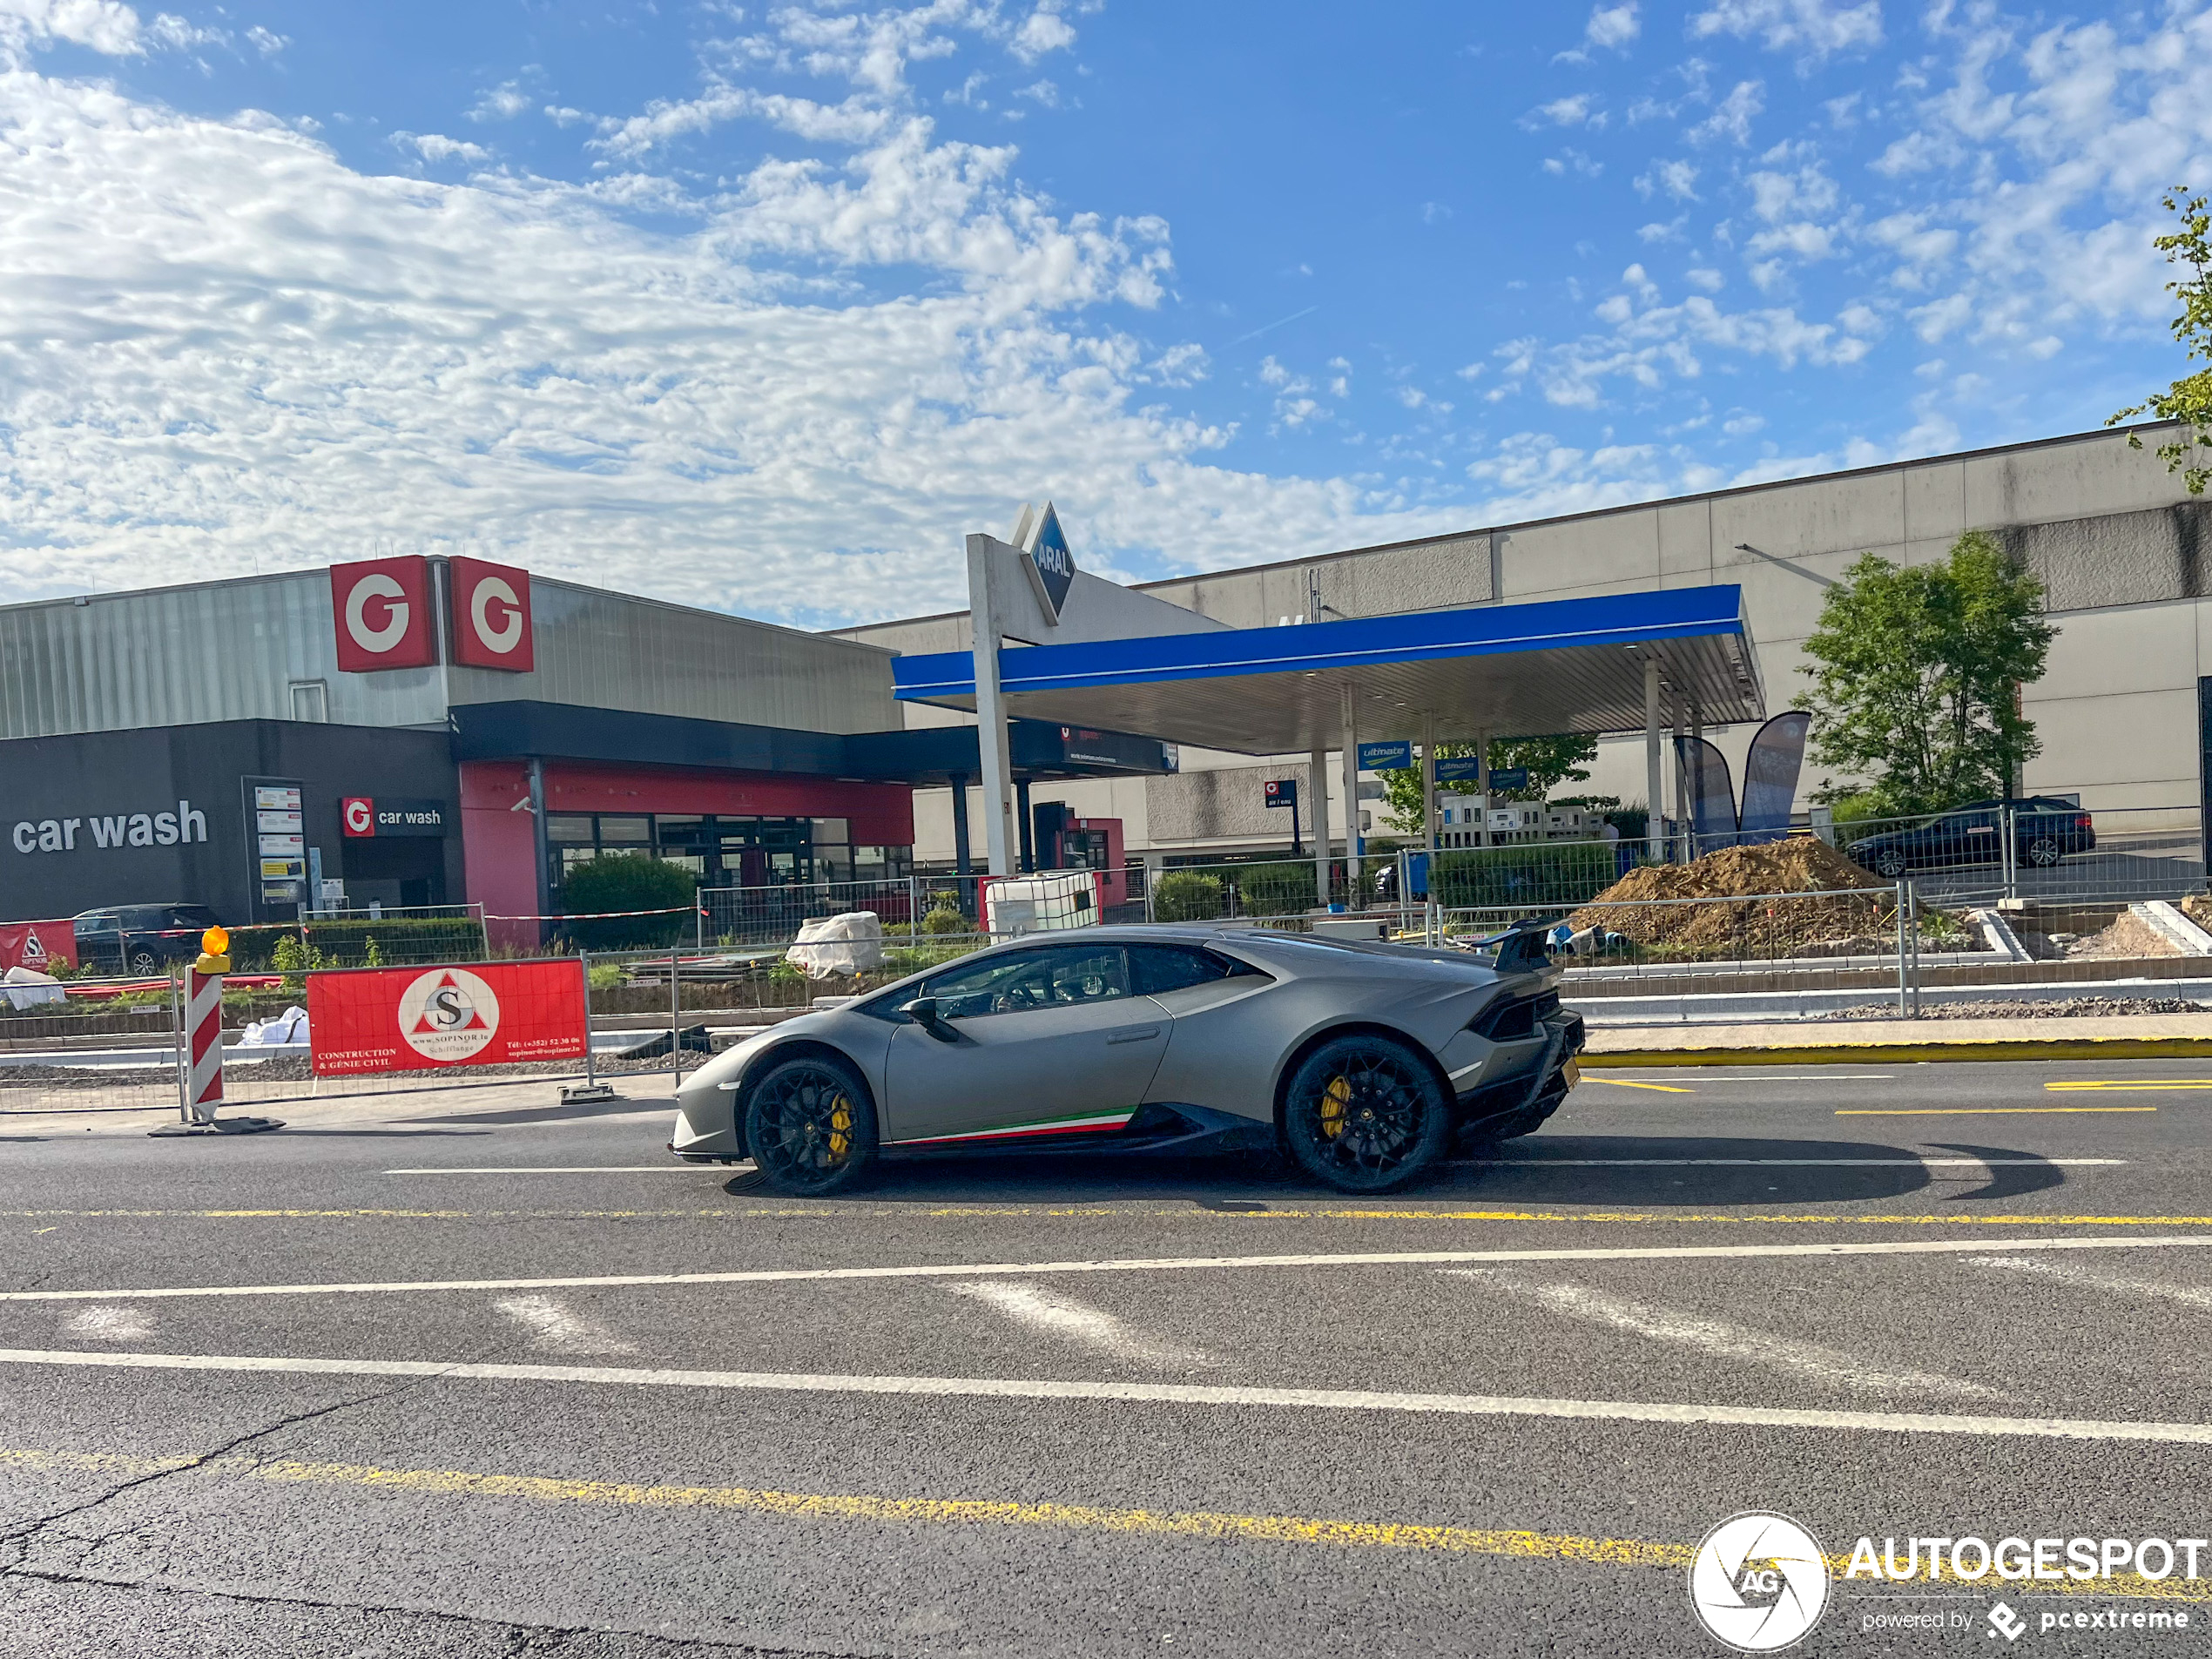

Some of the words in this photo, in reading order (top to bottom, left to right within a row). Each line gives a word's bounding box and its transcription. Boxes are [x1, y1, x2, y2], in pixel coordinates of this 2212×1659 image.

[1038, 542, 1070, 578] ARAL
[346, 573, 409, 652] G
[471, 577, 523, 653] G
[1364, 746, 1405, 756] ultimate
[13, 818, 81, 853] car
[89, 799, 207, 848] wash
[347, 801, 370, 832] G
[378, 812, 401, 824] car
[405, 809, 441, 824] wash
[436, 991, 462, 1025] S
[318, 1048, 396, 1060] CONSTRUCTION
[523, 1035, 548, 1048] (+352)
[329, 1059, 361, 1069] GÉNIE
[363, 1058, 390, 1067] CIVIL
